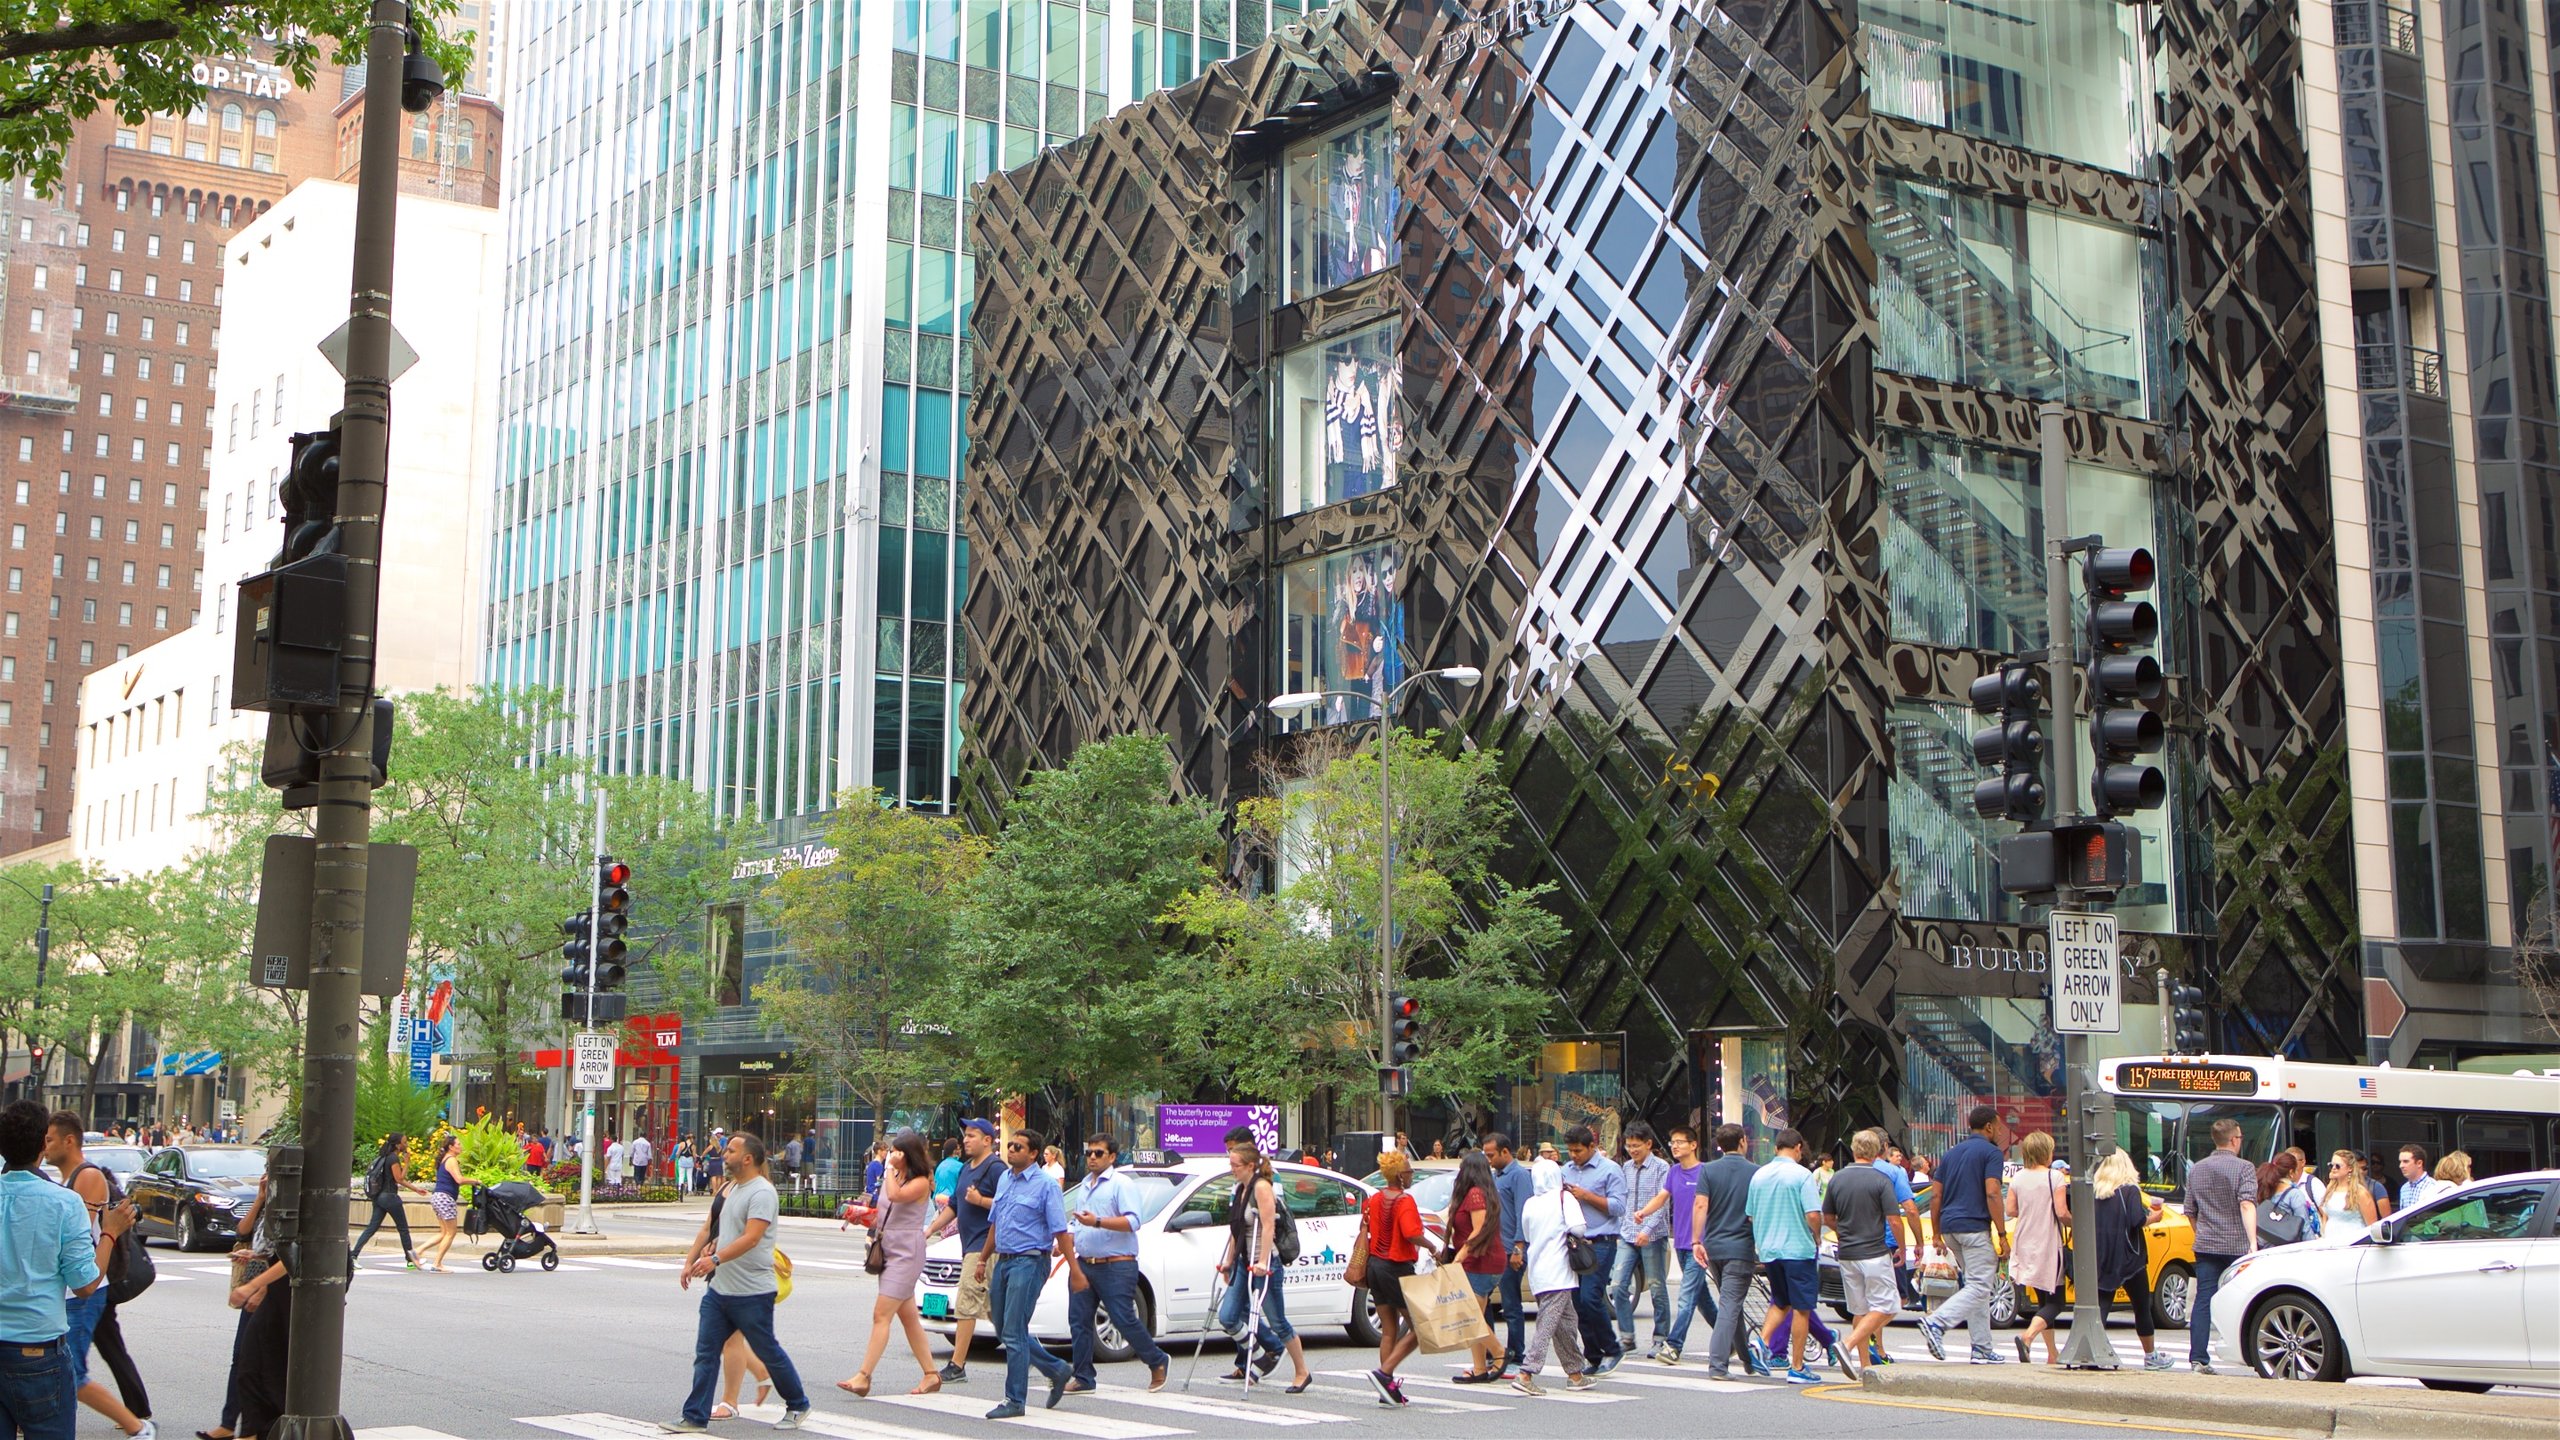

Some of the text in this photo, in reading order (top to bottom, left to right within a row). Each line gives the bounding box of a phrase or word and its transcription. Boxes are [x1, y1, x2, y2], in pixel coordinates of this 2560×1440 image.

[2056, 919, 2113, 944] LEFT ON
[1952, 945, 2144, 978] BURBY
[2064, 947, 2108, 970] GREEN
[2063, 974, 2111, 997] ARROW
[2071, 1000, 2104, 1023] ONLY
[414, 1021, 431, 1041] H
[578, 1037, 613, 1048] LEFT ON
[581, 1049, 608, 1060] GREEN
[579, 1062, 609, 1072] ARROW
[583, 1074, 604, 1085] ONLY
[2130, 1067, 2251, 1088] 157 STREETERVILLE/TAYLOR
[2179, 1079, 2221, 1091] TO OGDEN
[1166, 1107, 1233, 1119] The butterfly to regular
[1165, 1117, 1198, 1128] shopping's
